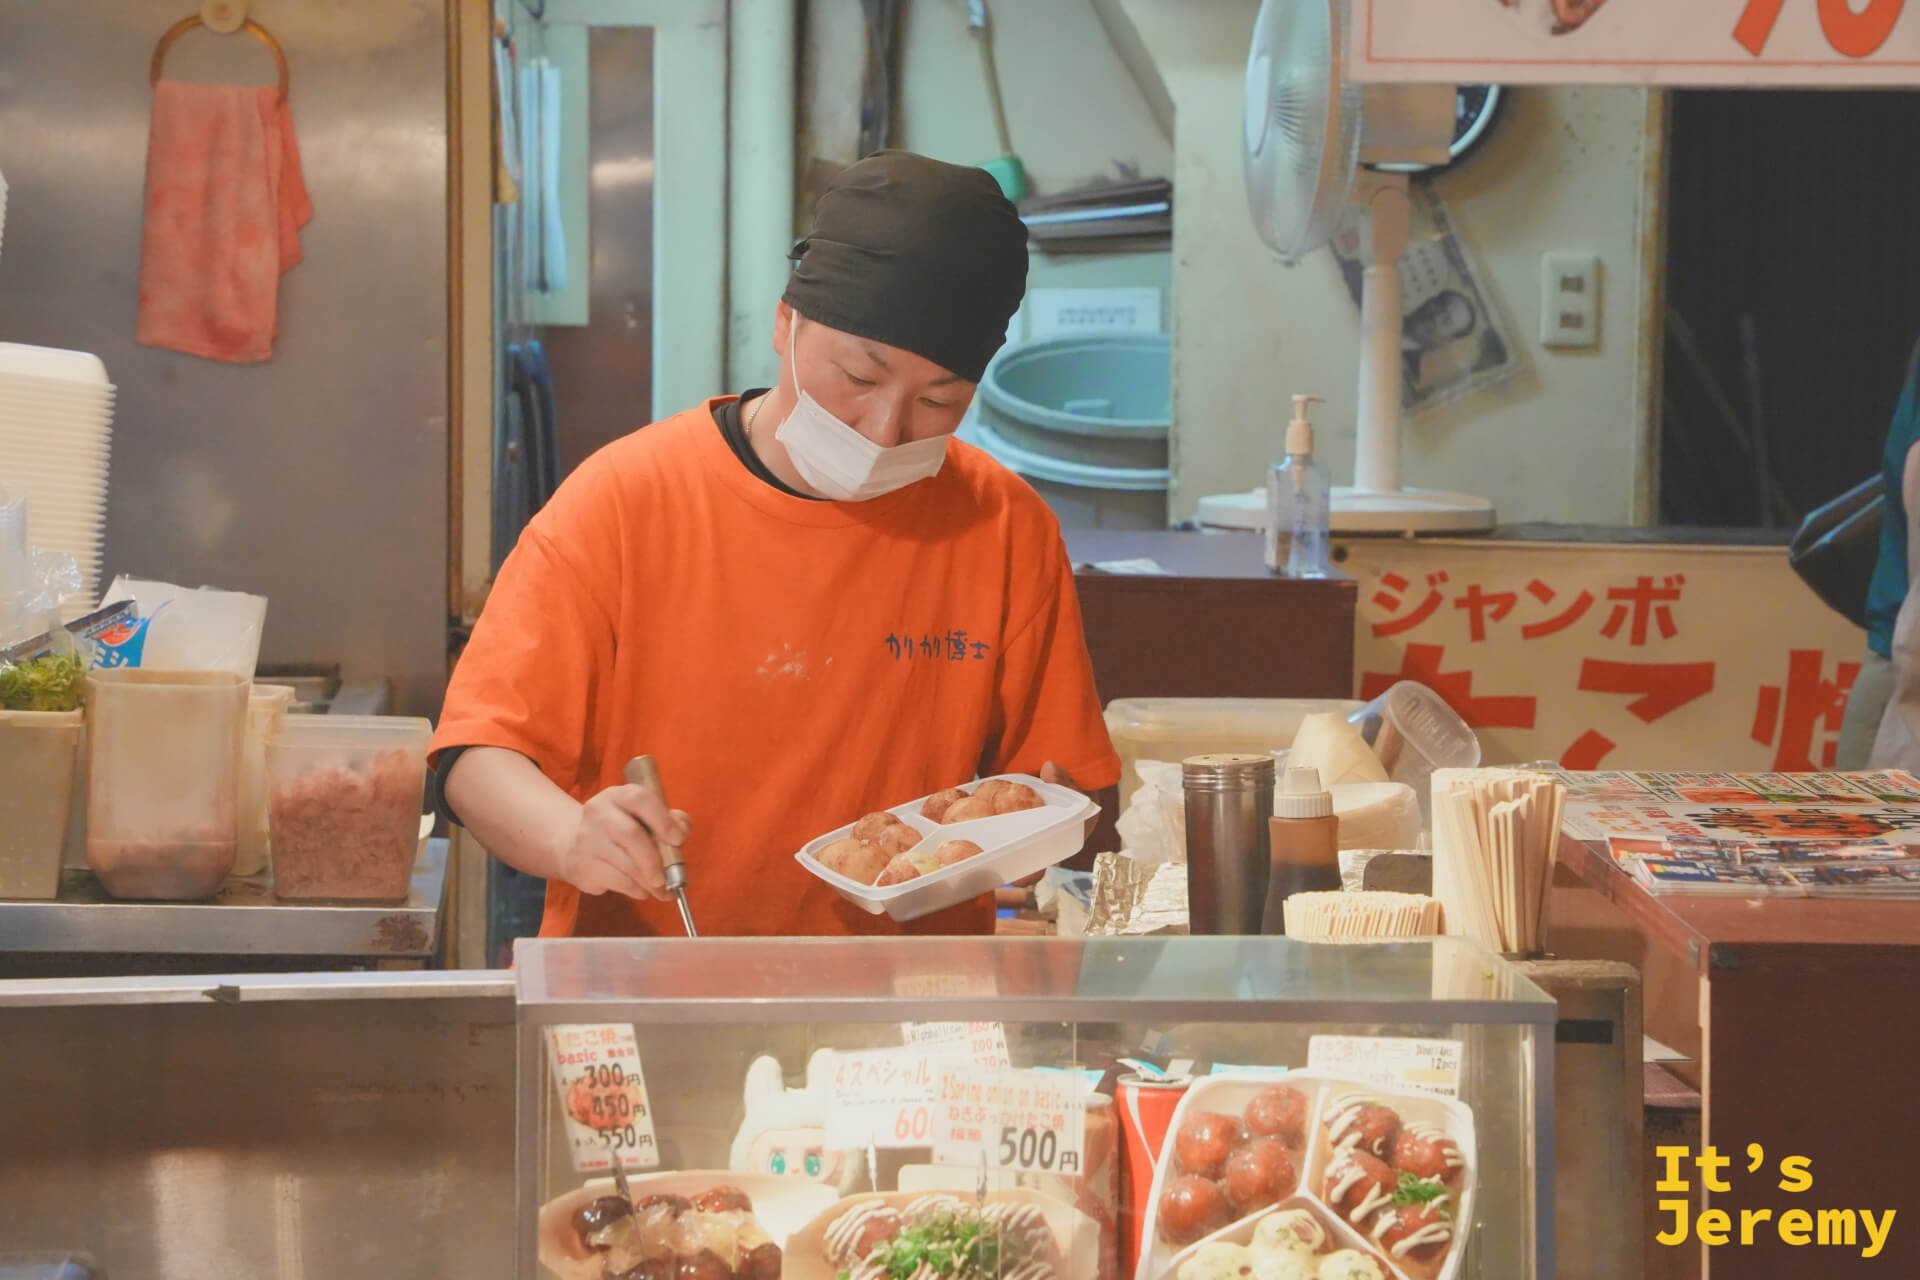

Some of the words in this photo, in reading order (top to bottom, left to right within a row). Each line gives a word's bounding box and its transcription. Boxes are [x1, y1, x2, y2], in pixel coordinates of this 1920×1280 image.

[1371, 570, 1686, 646] ジャンボ
[557, 1048, 598, 1065] basic
[895, 1106, 936, 1140] 60
[1000, 1127, 1078, 1172] 500円
